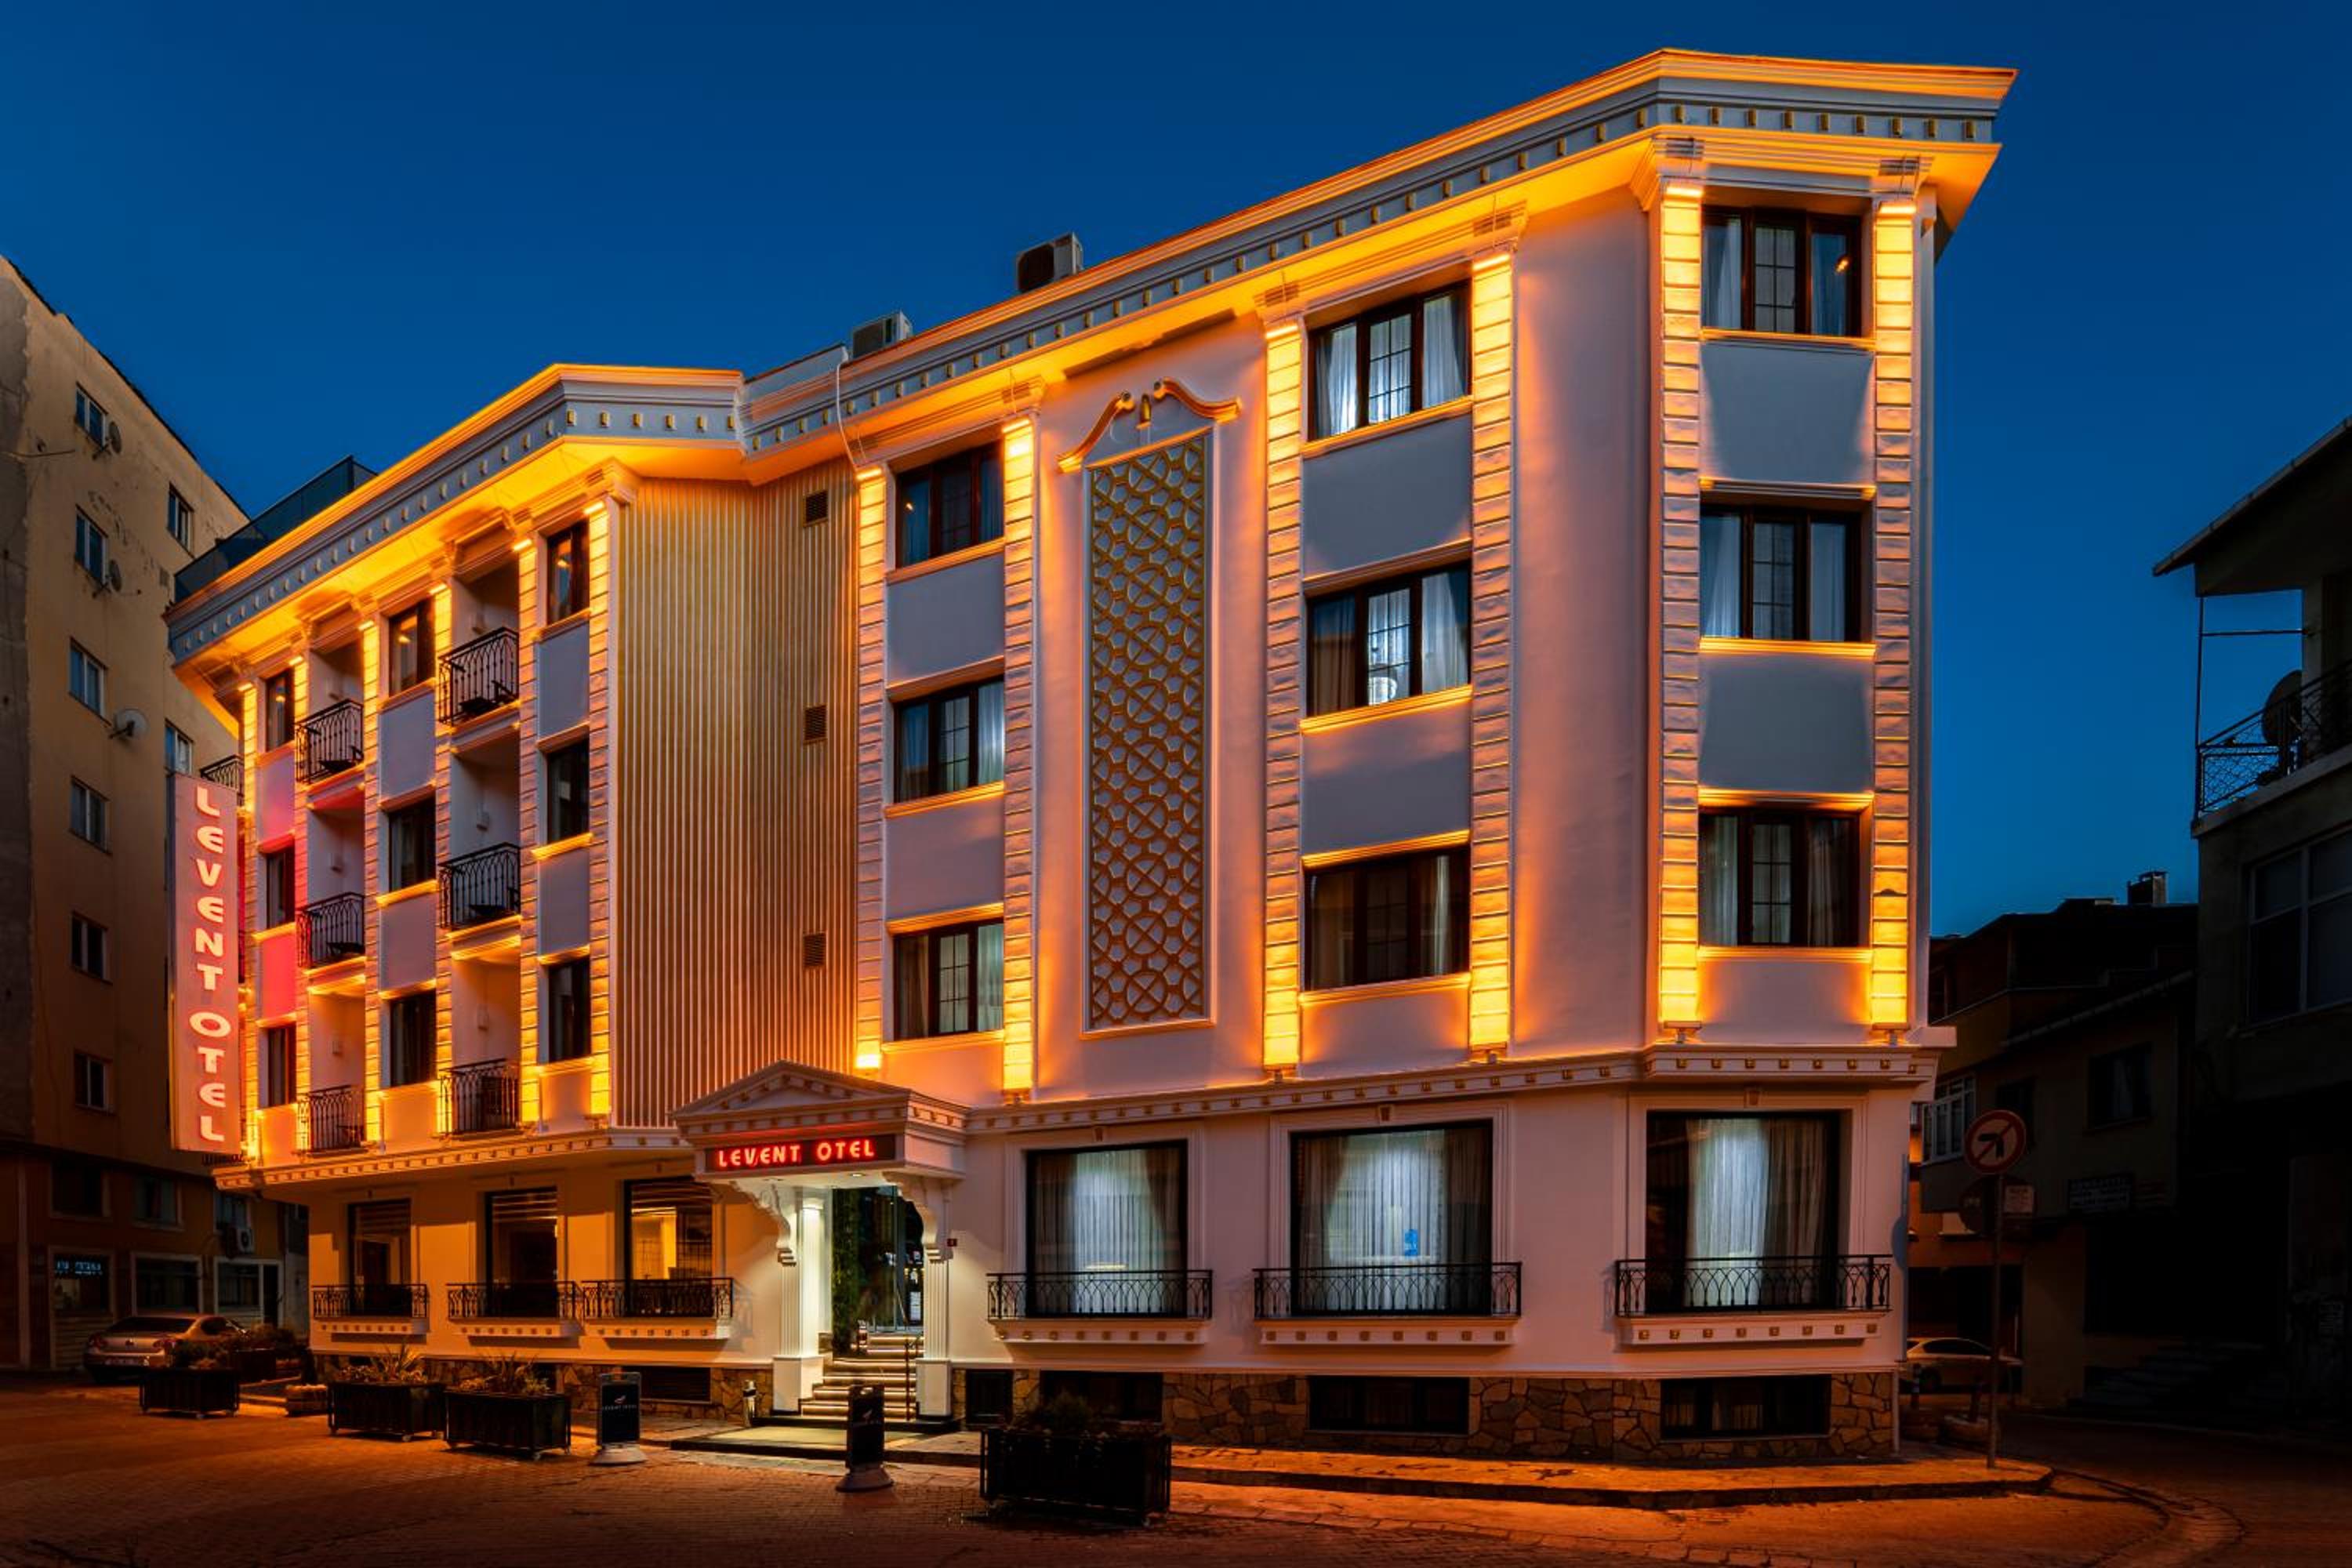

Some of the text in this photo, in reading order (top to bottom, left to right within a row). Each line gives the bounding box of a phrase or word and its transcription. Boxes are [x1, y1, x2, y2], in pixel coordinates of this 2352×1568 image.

[189, 786, 231, 1142] LEVENT OTEL
[718, 1139, 875, 1167] LEVENT OTEL
